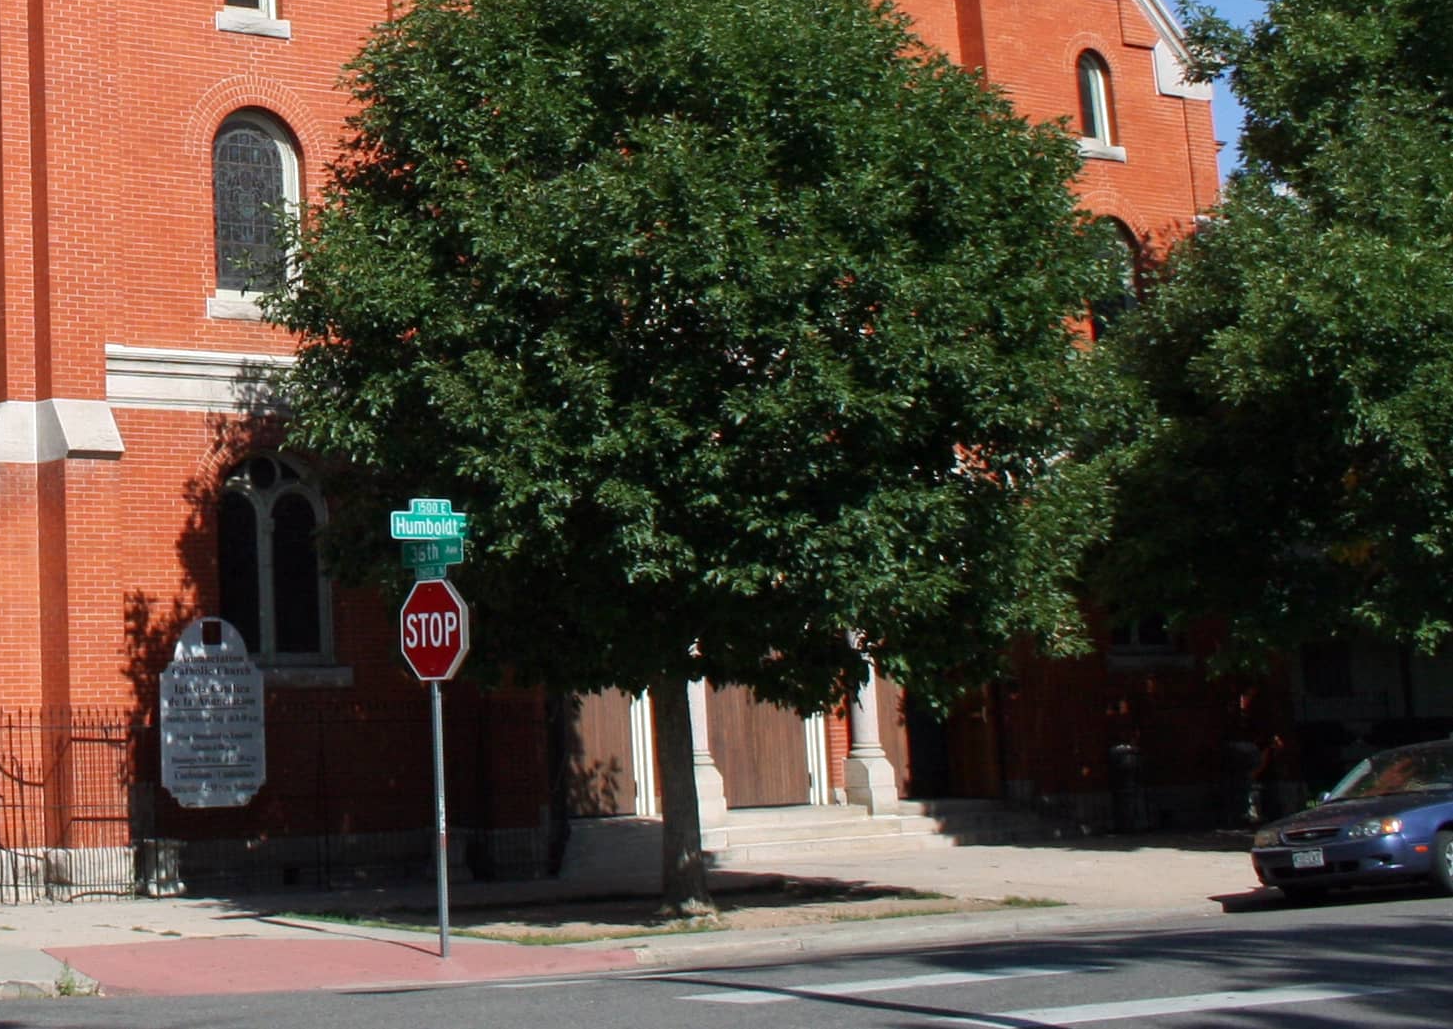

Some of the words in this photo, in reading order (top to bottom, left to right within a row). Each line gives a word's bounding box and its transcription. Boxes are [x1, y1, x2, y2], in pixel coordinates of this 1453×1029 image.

[396, 516, 458, 535] Humboldt
[411, 543, 439, 563] 36th
[405, 612, 457, 649] STOP
[171, 665, 212, 676] Catholic
[216, 665, 252, 676] Church
